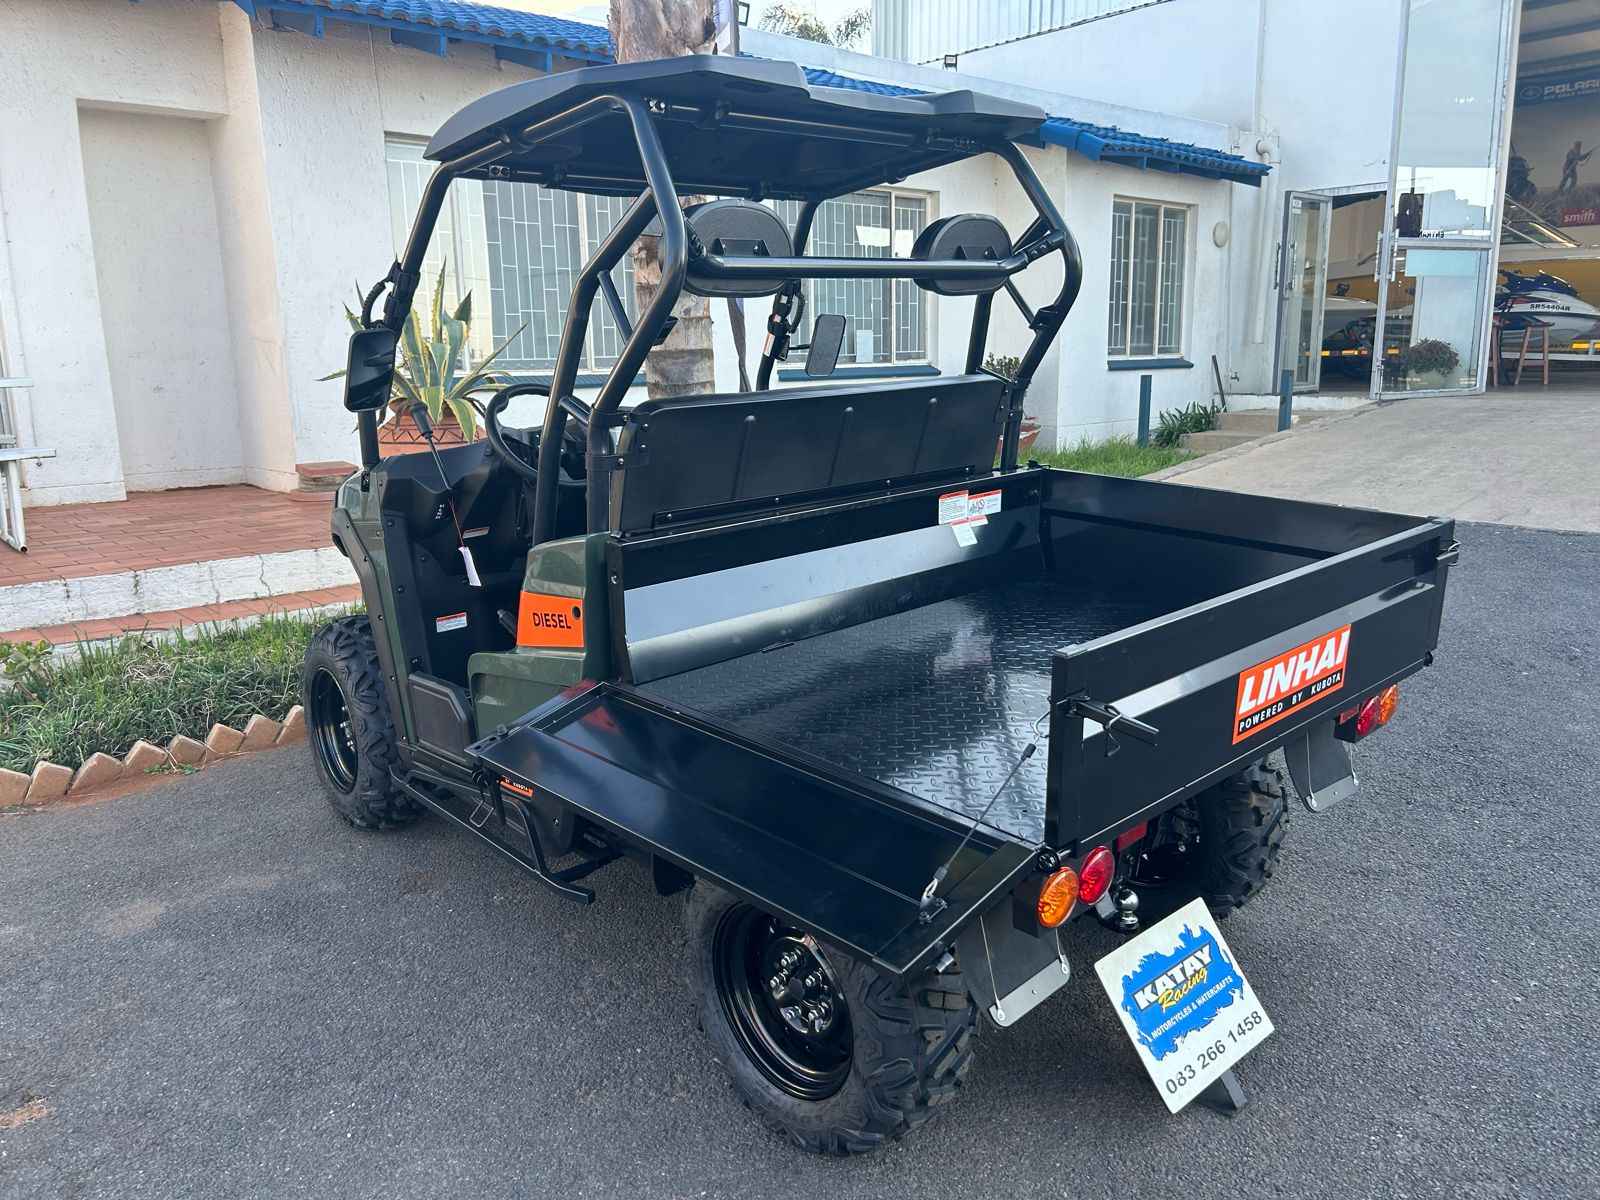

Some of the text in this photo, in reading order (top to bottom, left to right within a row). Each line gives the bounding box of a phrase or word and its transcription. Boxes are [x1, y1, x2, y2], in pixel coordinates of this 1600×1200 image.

[1543, 79, 1600, 96] POLARI
[1563, 209, 1596, 223] smith
[532, 612, 572, 630] DIESEL
[1238, 629, 1351, 715] LINHAI
[1239, 672, 1341, 732] POWERED BY KUBOTA
[1134, 943, 1213, 1012] KATAY
[1151, 975, 1234, 1040] MOTORCYCLES & WATERCRAFTS
[1158, 967, 1208, 1014] Racing
[1165, 1010, 1262, 1094] 083 266 1458
